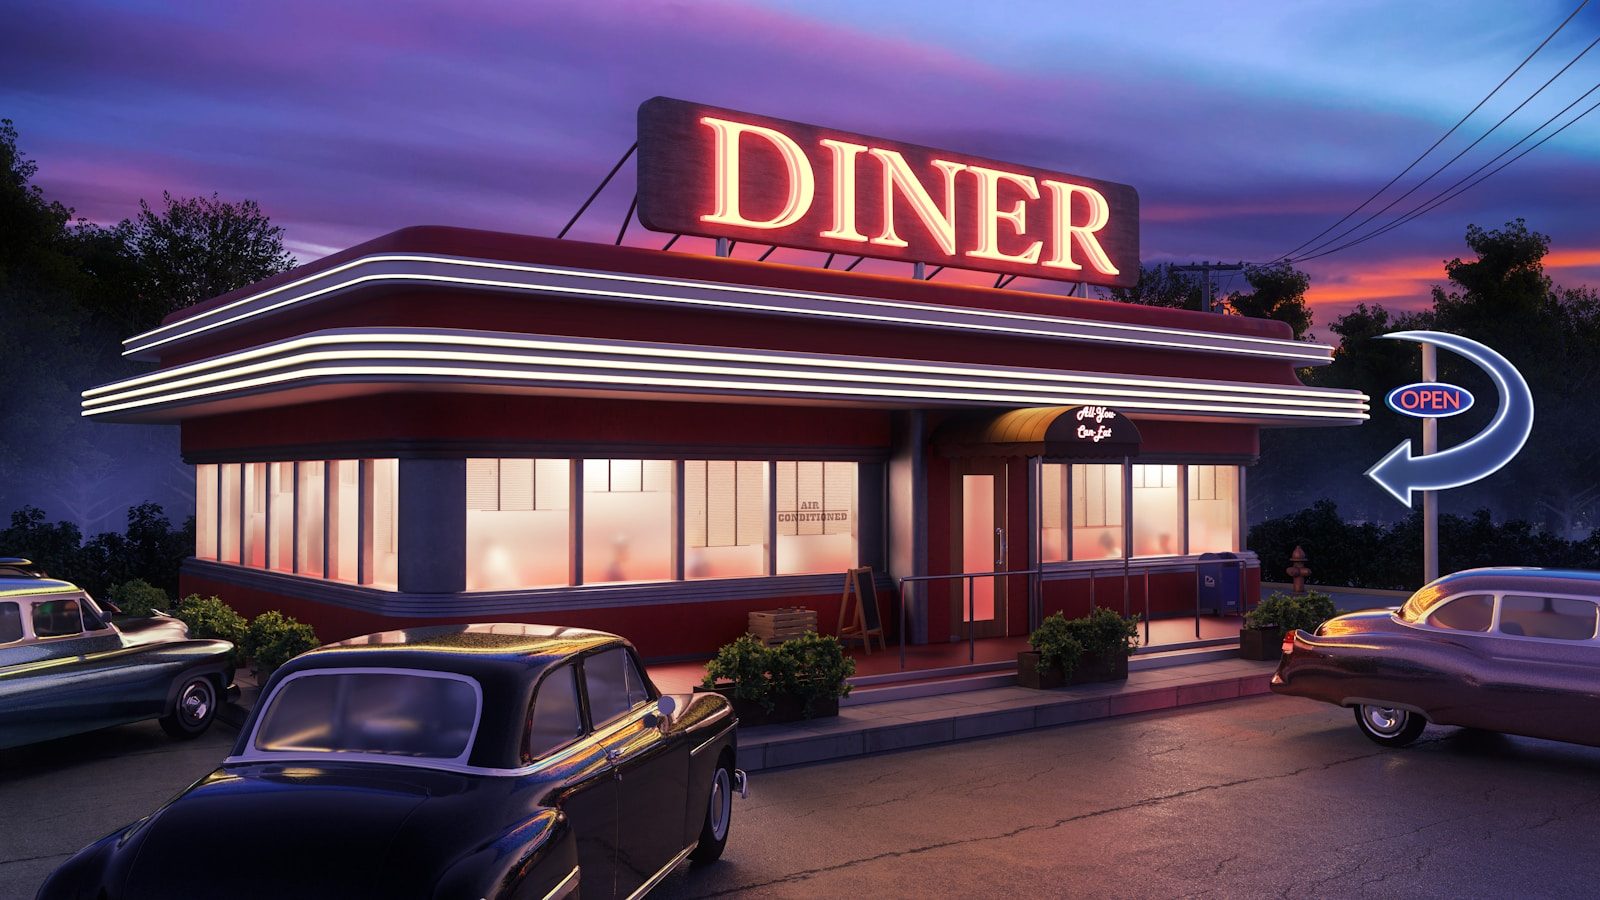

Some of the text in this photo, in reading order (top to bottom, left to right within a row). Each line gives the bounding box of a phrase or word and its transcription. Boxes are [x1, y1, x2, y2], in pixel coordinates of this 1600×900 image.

[700, 116, 1119, 276] DINER
[1401, 390, 1459, 409] OPEN
[800, 501, 820, 510] AIR
[778, 512, 848, 522] CONDITIONED
